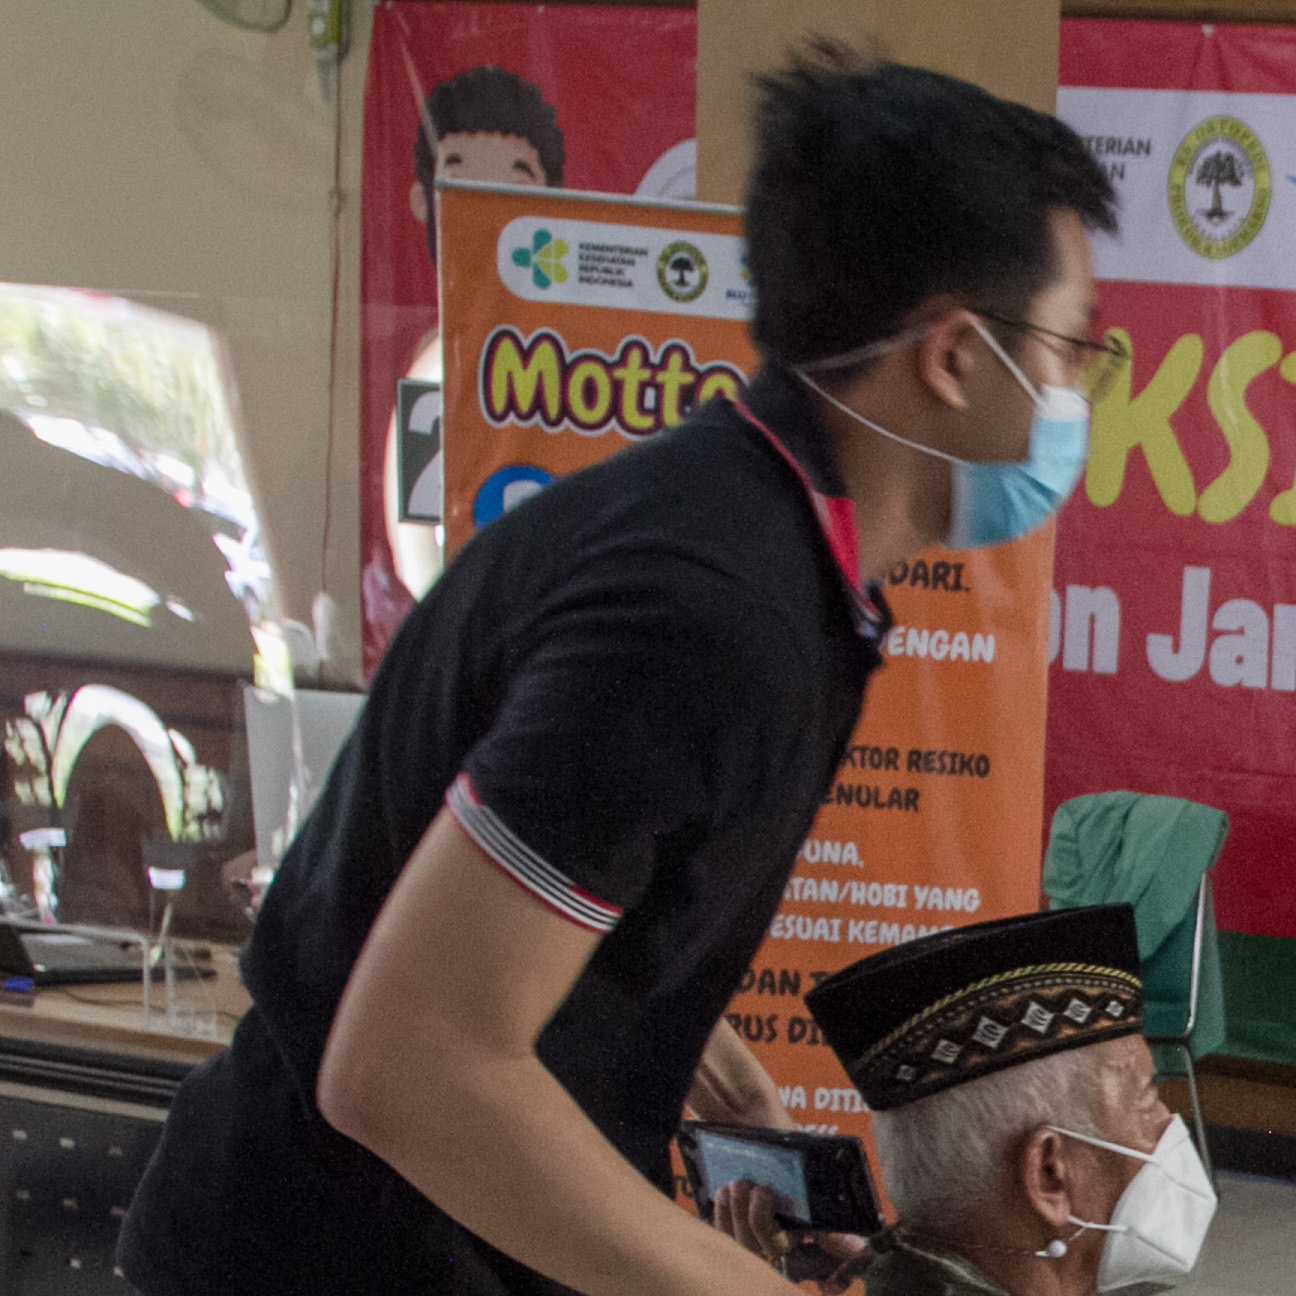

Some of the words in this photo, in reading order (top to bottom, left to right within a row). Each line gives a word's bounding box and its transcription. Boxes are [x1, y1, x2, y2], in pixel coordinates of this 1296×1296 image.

[1083, 136, 1152, 156] TERIAN
[887, 558, 971, 593] DARI.
[887, 625, 996, 664] ENGAN
[906, 748, 991, 778] RESIKO
[832, 783, 921, 813] NULAR
[786, 876, 909, 909] TAN/HOBI
[913, 884, 981, 914] YANG
[769, 914, 843, 943] ESUAI
